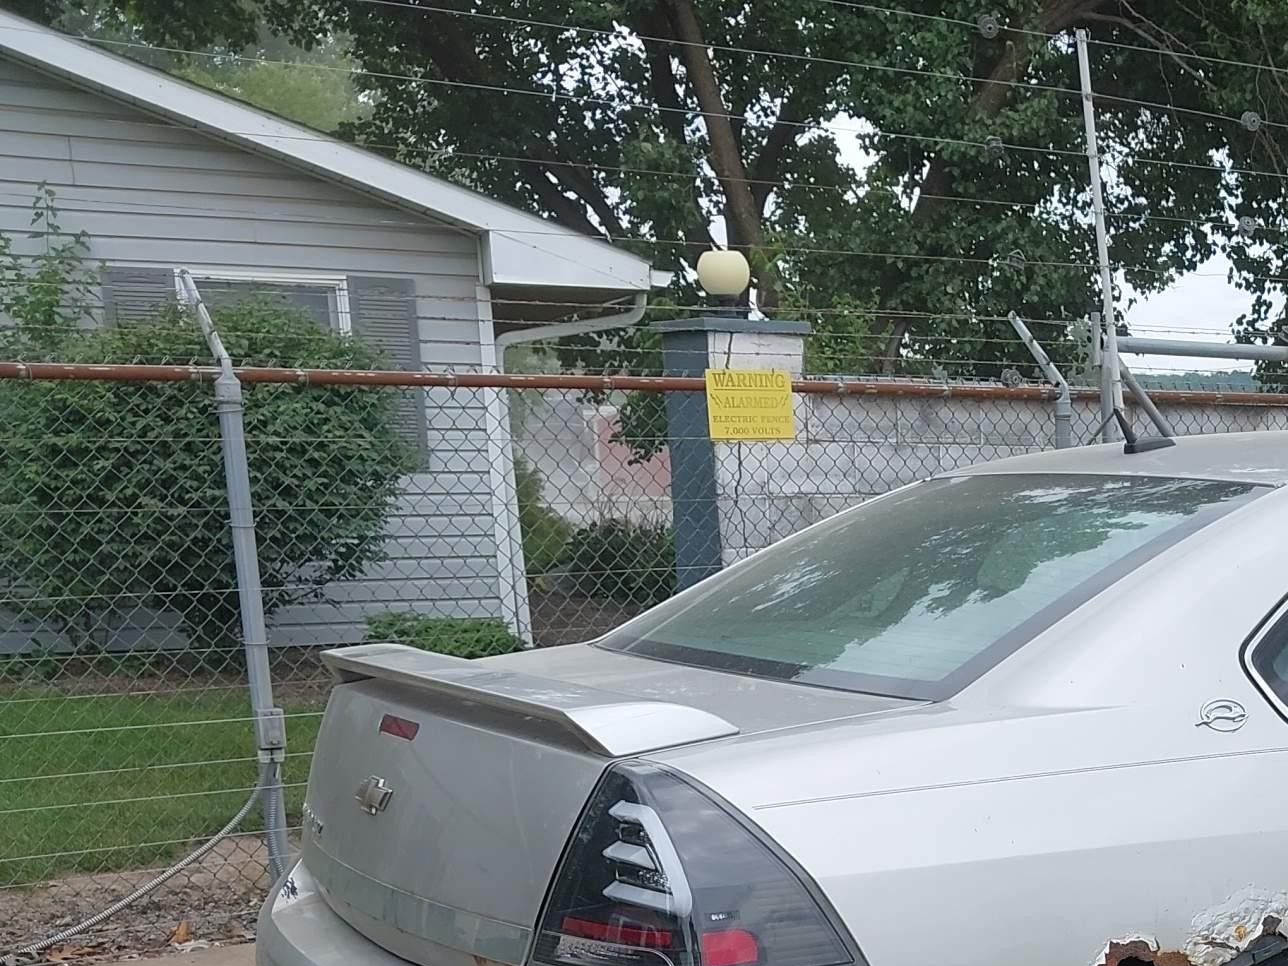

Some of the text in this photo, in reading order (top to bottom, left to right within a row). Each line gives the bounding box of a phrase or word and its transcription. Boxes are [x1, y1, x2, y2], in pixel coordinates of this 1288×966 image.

[712, 373, 785, 388] WARNING
[724, 396, 778, 409] ALARMED
[760, 416, 790, 424] FENCE
[724, 427, 781, 435] 7,000 VOLTS
